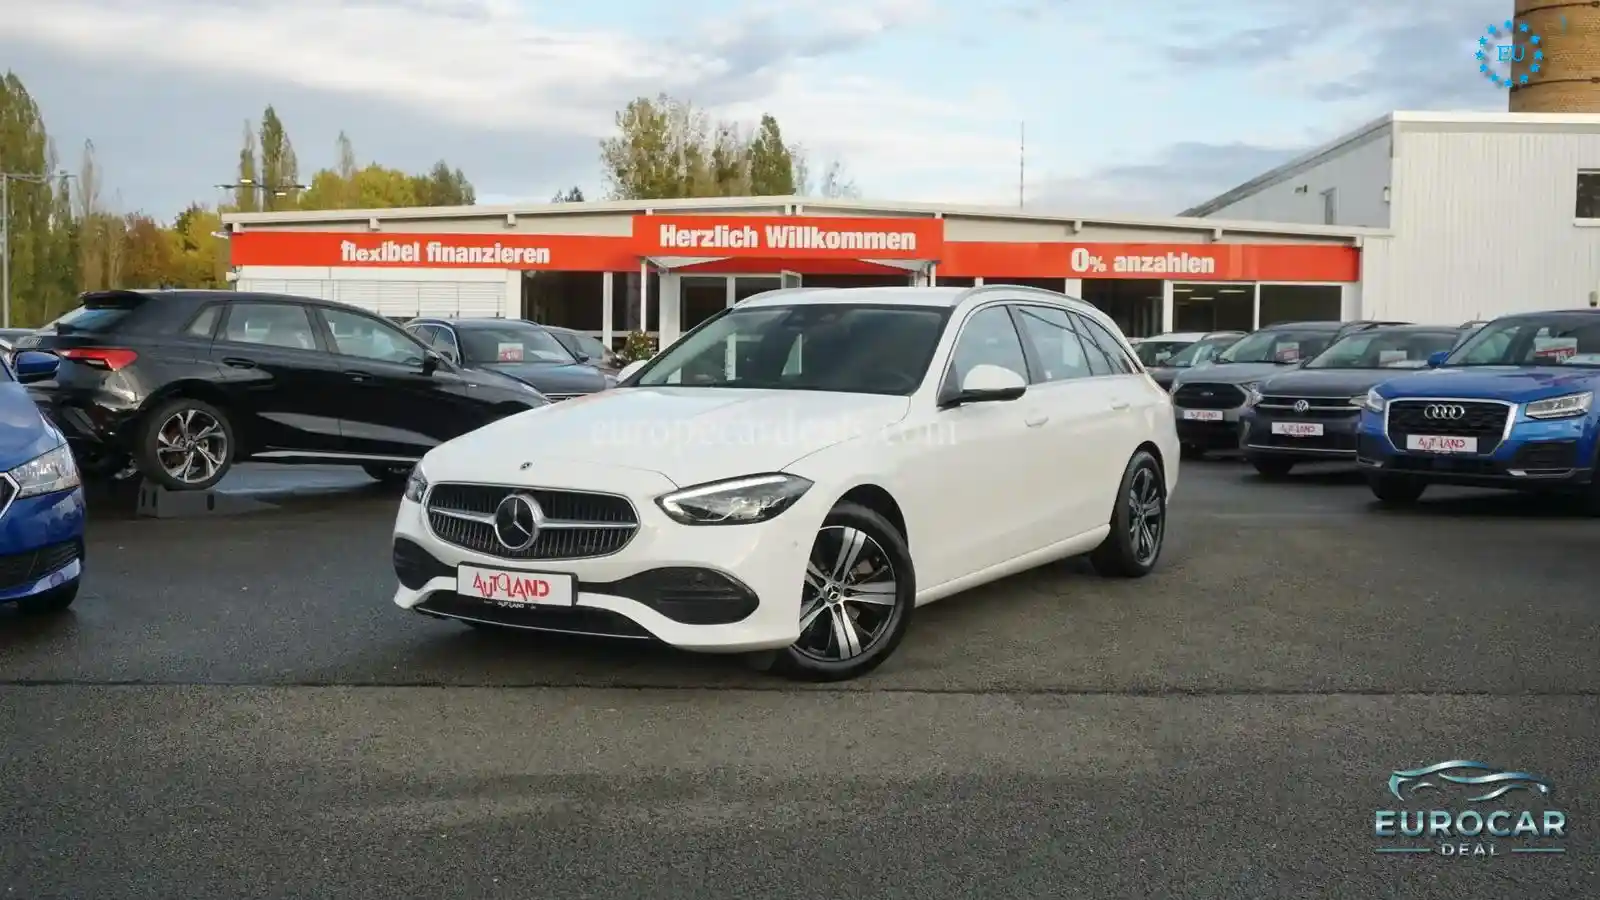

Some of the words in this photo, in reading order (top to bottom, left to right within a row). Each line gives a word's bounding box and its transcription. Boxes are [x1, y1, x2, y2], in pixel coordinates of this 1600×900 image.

[659, 225, 759, 248] Herzlich
[765, 226, 916, 250] Willkommen
[341, 240, 420, 263] flexibel
[426, 242, 550, 264] finanzieren
[1071, 248, 1106, 273] 0%
[1113, 251, 1215, 274] anzahlen
[472, 572, 550, 600] AUTOLAND
